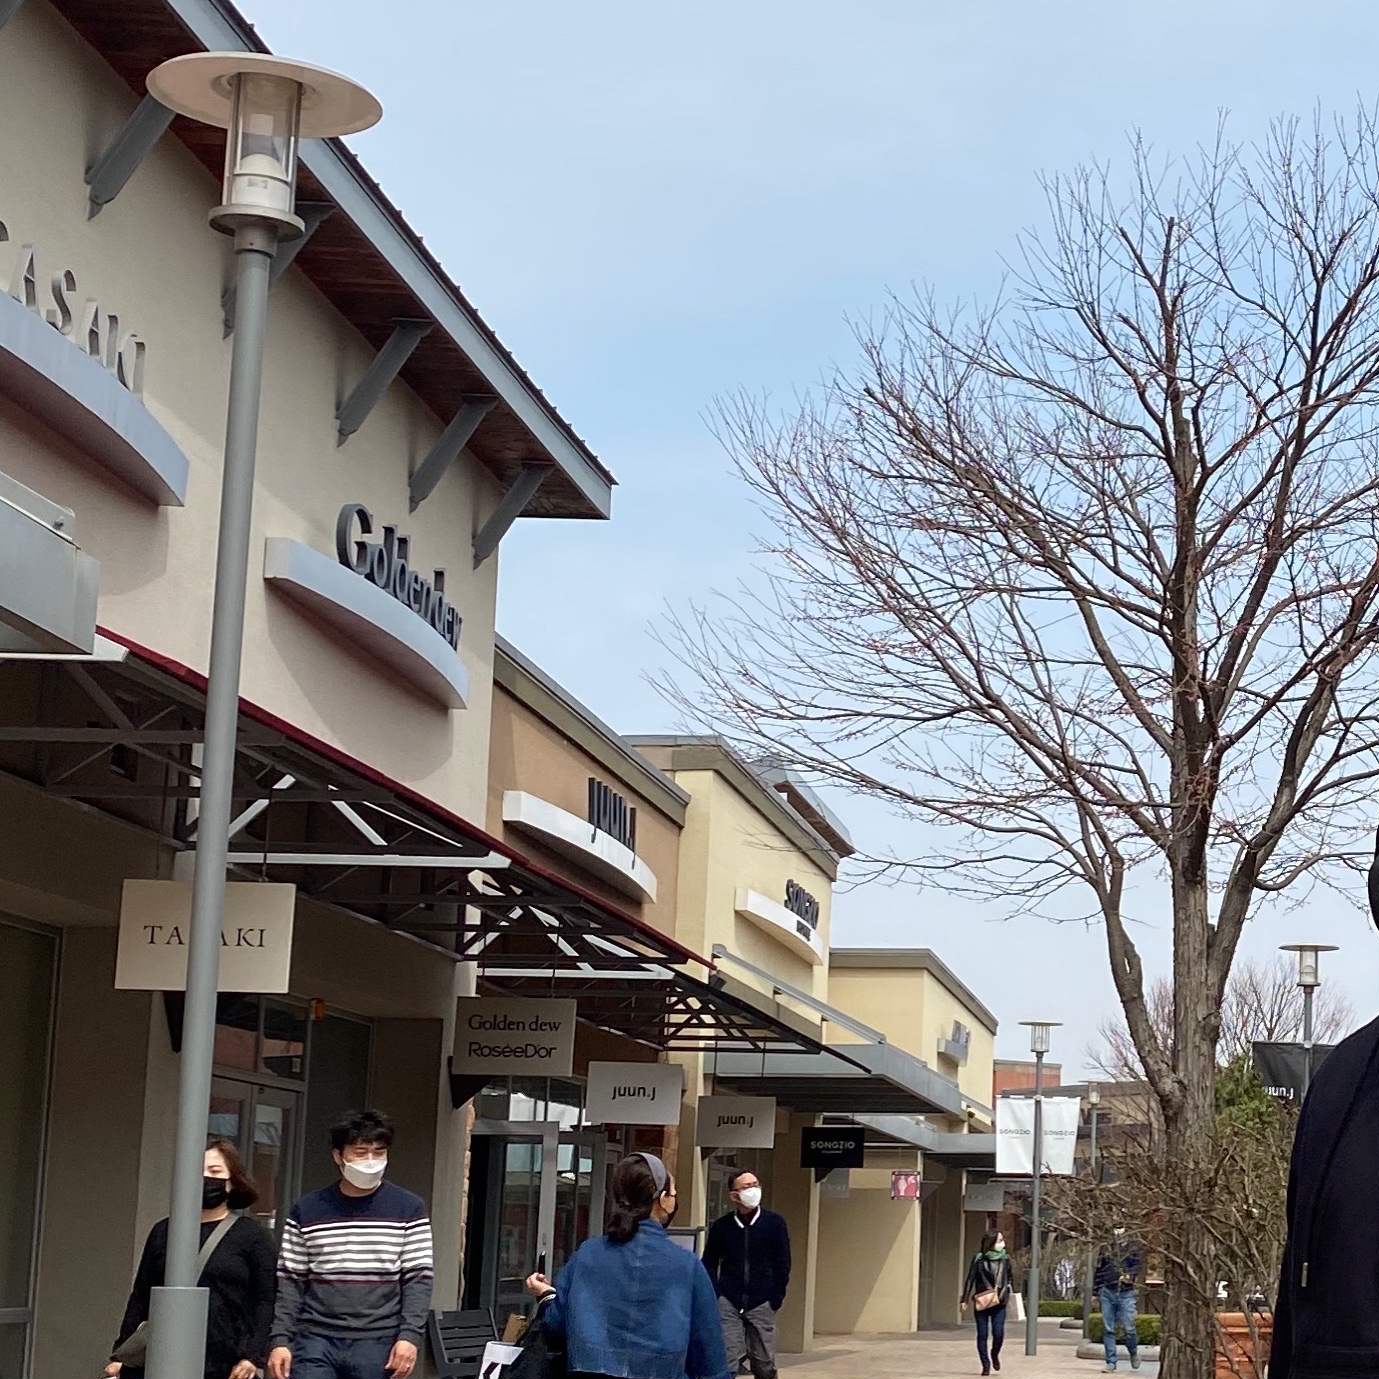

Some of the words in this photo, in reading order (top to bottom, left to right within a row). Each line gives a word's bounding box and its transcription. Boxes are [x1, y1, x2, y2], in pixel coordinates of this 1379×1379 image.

[0, 220, 146, 404] ASAKI
[143, 925, 266, 948] TAKI
[468, 1014, 526, 1031] Golden
[528, 1015, 561, 1032] dew
[611, 1085, 656, 1101] juun.j
[810, 1141, 856, 1150] SONGZIO
